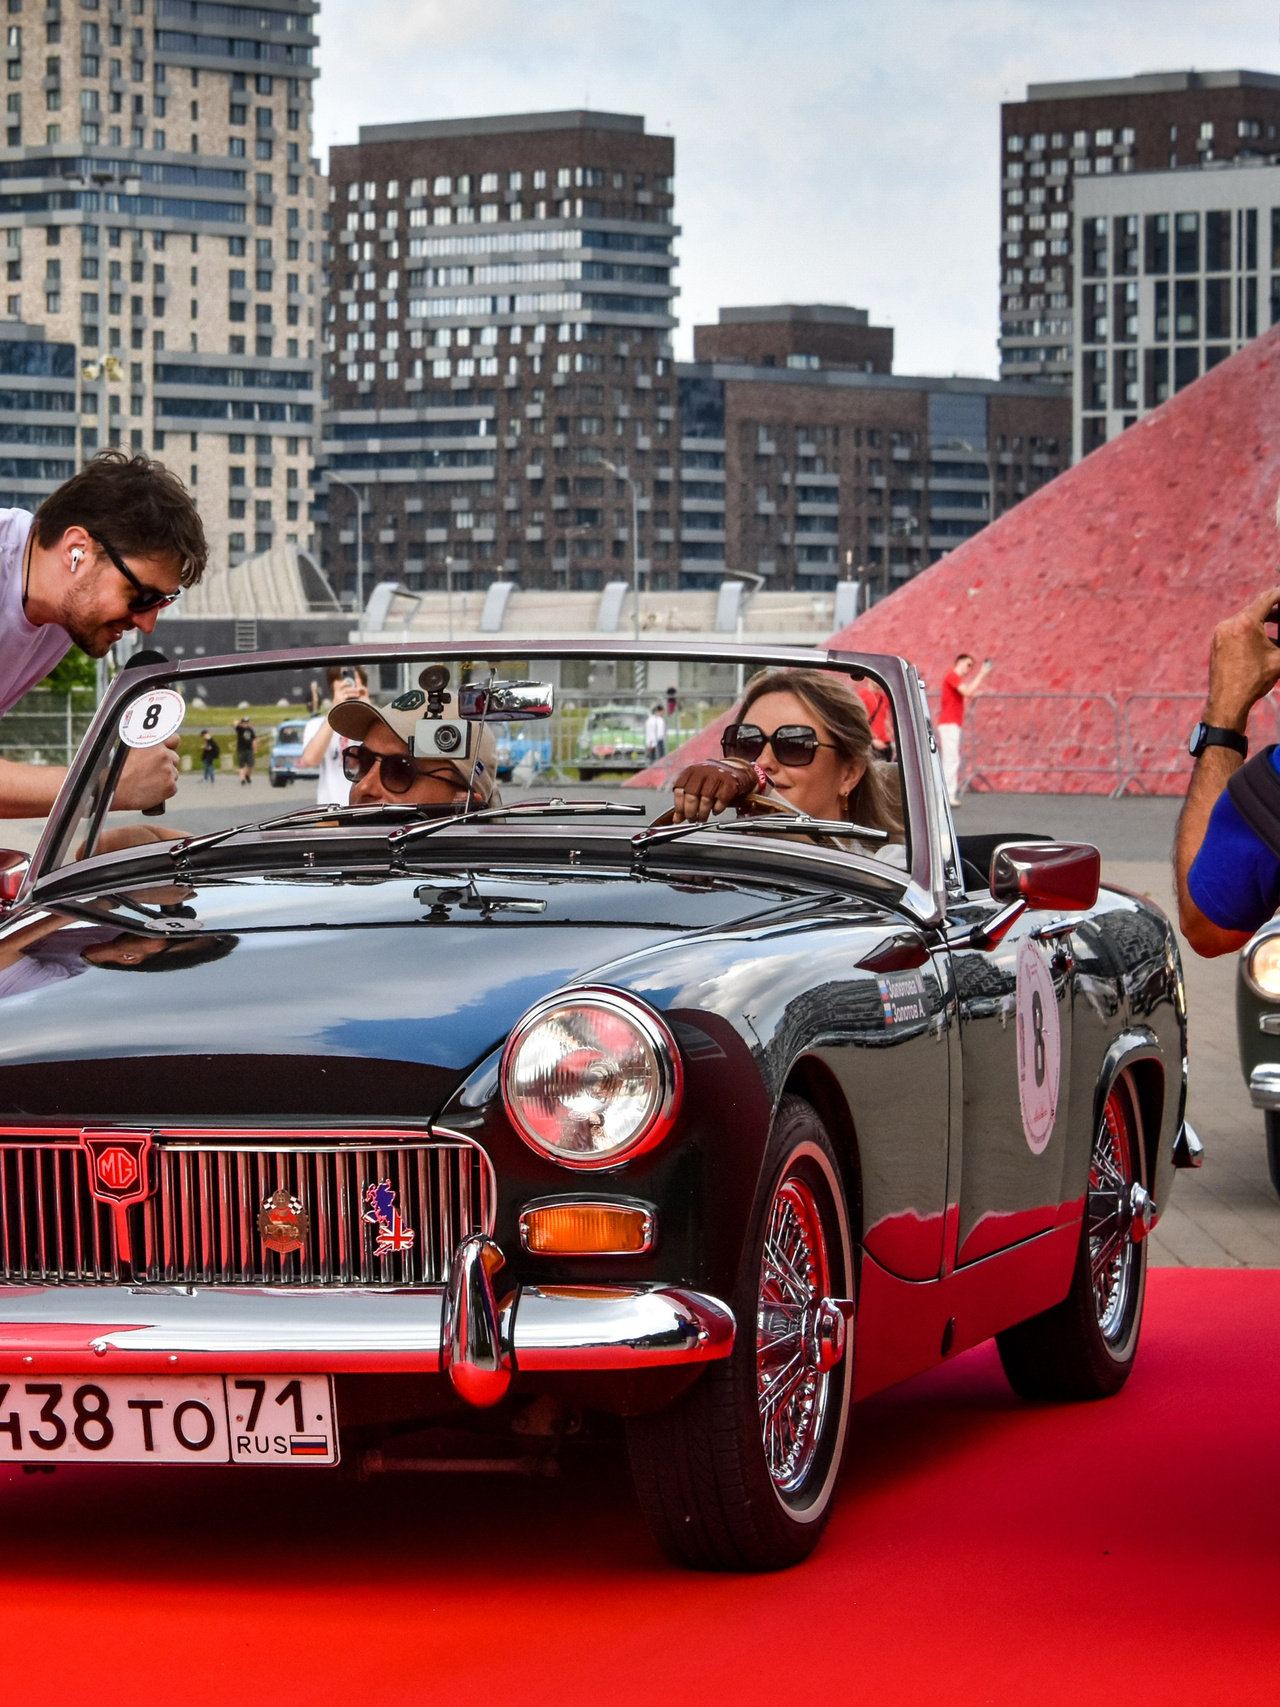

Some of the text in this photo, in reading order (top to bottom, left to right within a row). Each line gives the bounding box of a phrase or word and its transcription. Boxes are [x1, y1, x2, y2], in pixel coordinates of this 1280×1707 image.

[142, 703, 162, 730] 8
[1032, 991, 1045, 1088] 8
[102, 1152, 133, 1184] MG
[234, 1380, 305, 1433] 71
[237, 1436, 288, 1455] RUS
